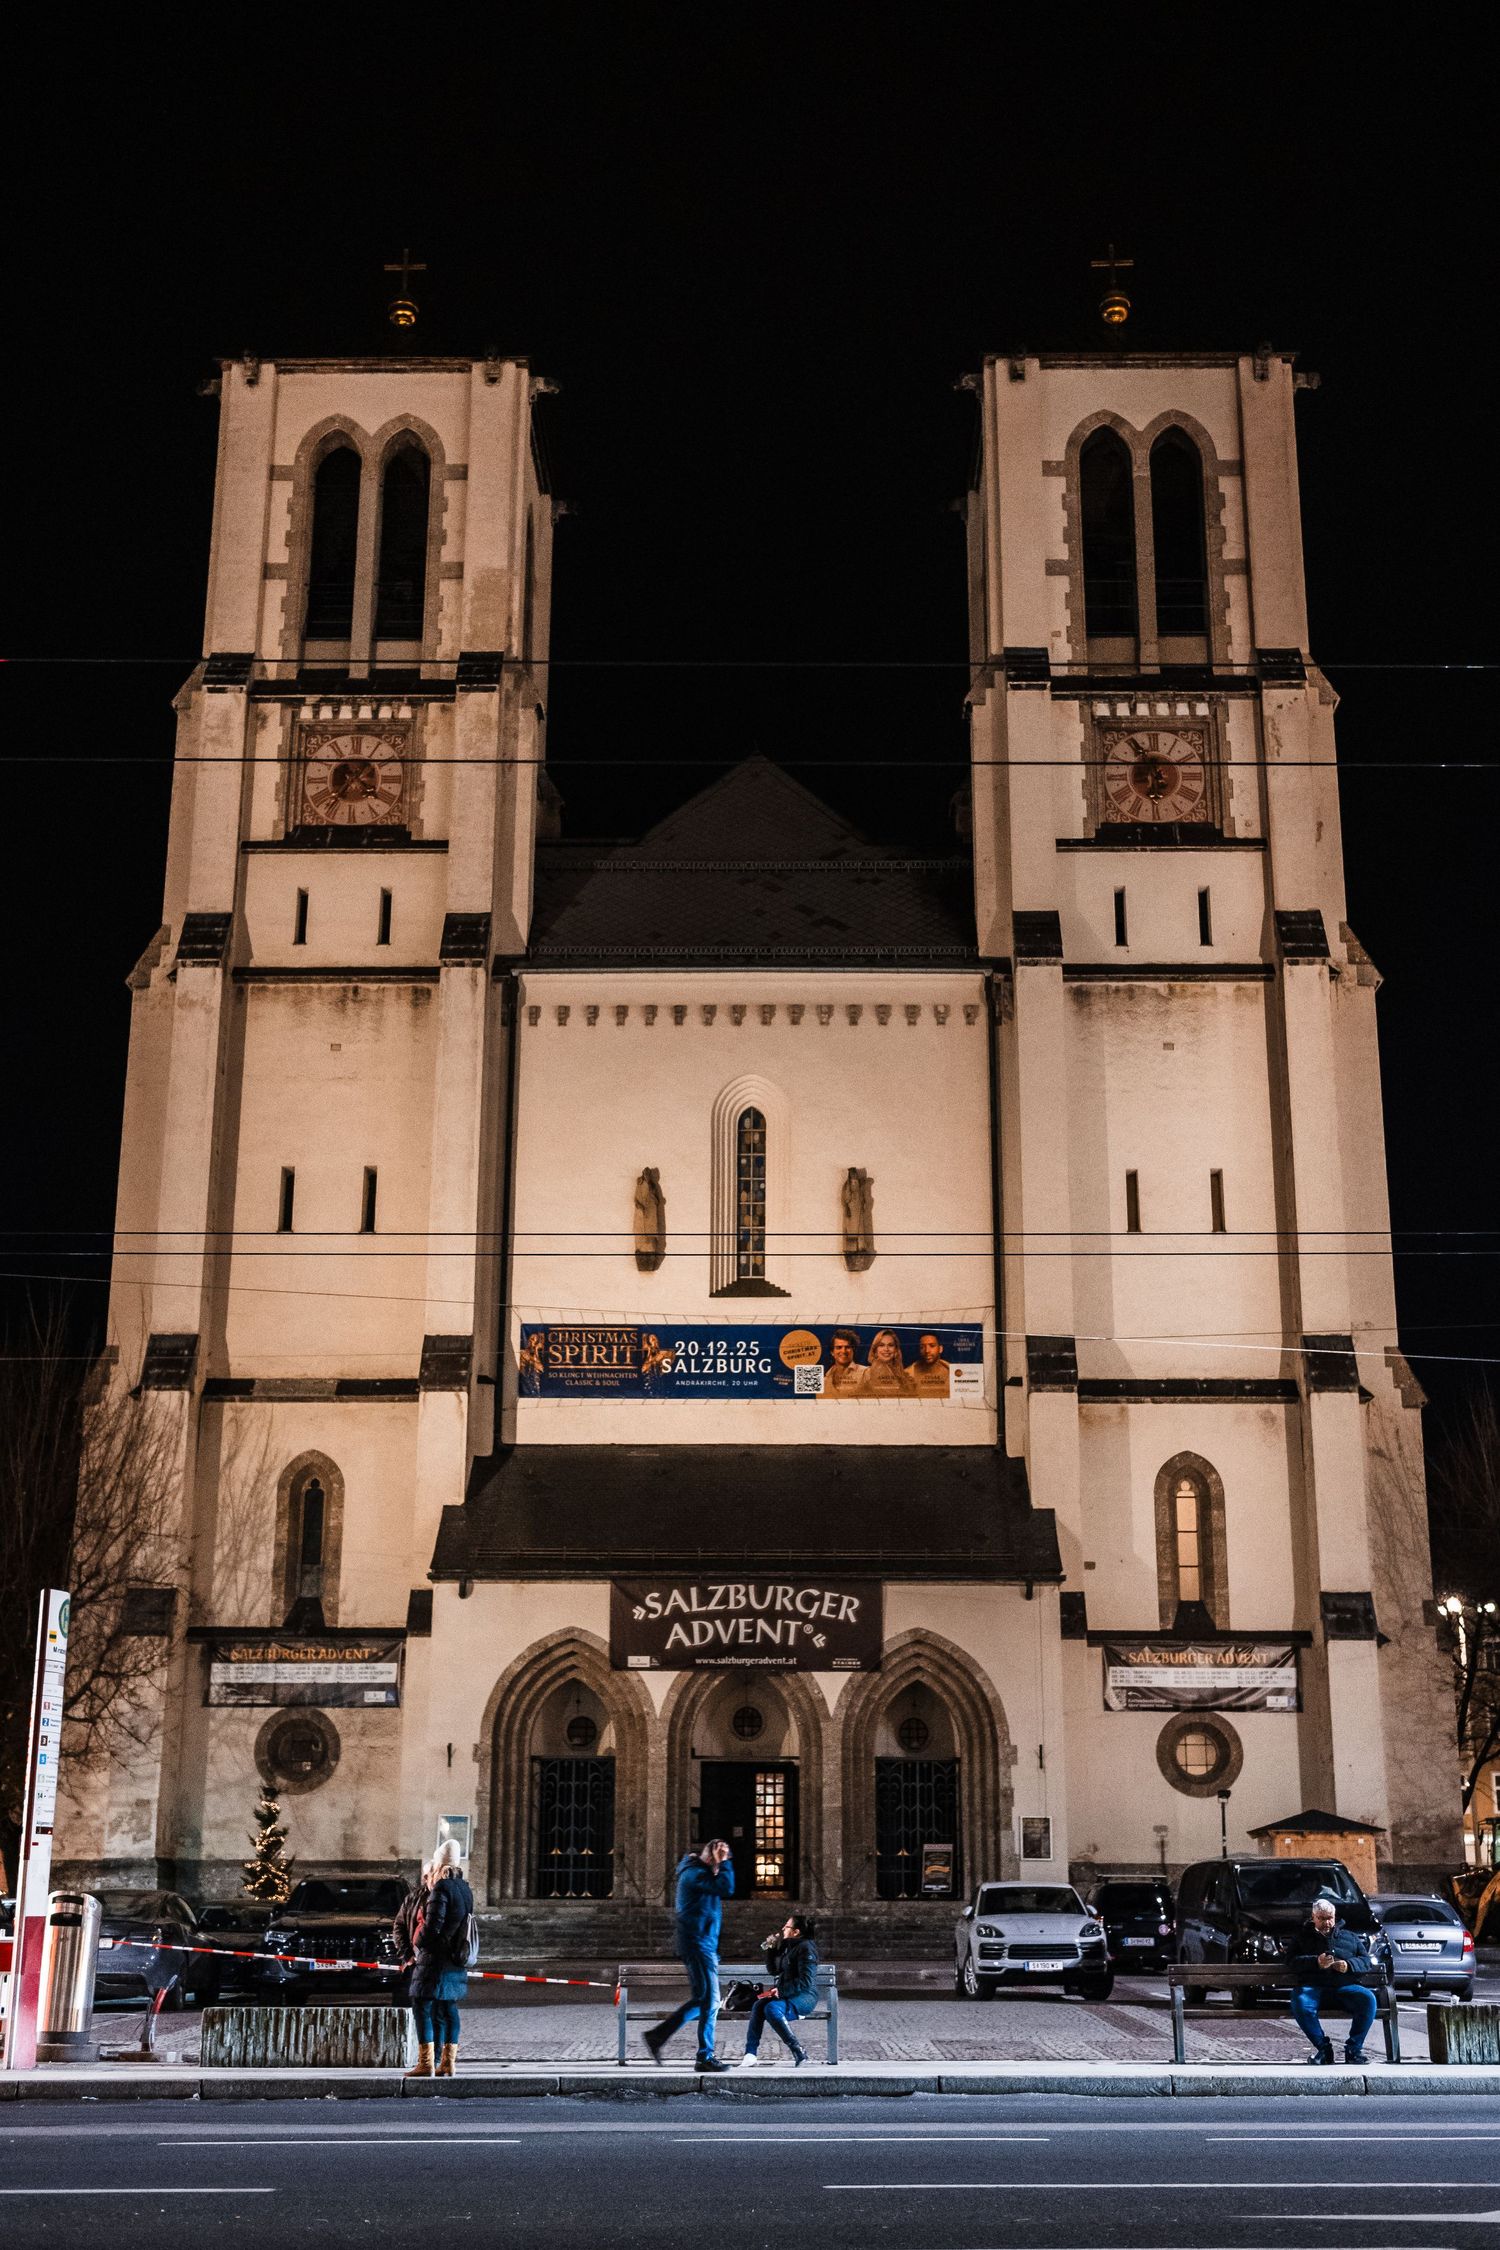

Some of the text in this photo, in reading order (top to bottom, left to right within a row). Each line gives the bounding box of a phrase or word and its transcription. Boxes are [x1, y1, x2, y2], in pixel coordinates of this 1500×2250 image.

[548, 1331, 638, 1344] CHRISTMAS
[548, 1344, 637, 1365] SPIRIT
[674, 1340, 760, 1356] 20.12.25
[661, 1358, 772, 1374] SALZBURG
[230, 1647, 318, 1661] SALZBURGER
[695, 1655, 797, 1666] www.salzburgeradvent.at
[1128, 1651, 1214, 1665] SALZBURGER
